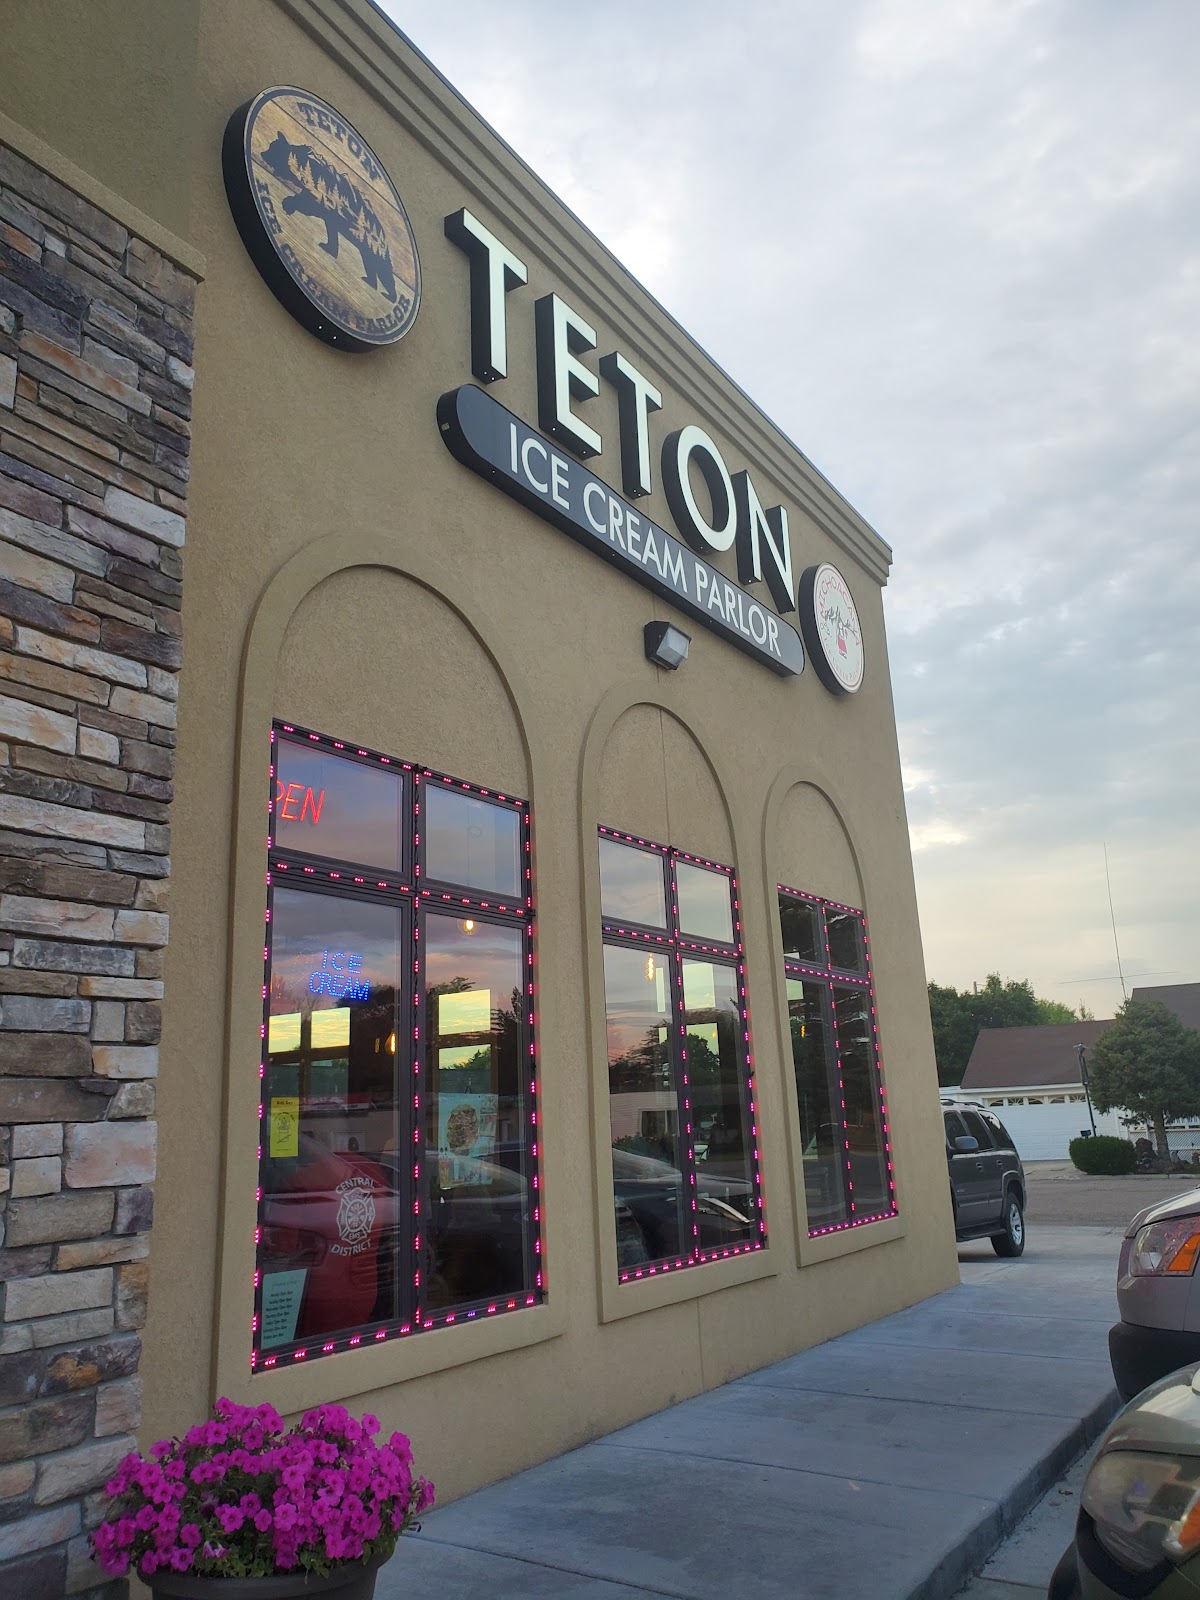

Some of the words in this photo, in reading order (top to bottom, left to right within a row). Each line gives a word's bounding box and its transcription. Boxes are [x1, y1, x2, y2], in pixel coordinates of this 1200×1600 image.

[297, 102, 381, 181] TETON
[255, 179, 283, 235] ICE
[354, 294, 411, 333] PARLOR
[462, 206, 796, 613] TETON
[509, 422, 571, 511] ICE
[582, 481, 689, 594] CREAM
[694, 561, 783, 658] PARLOR
[276, 780, 326, 824] PEN
[322, 950, 363, 975] ICE
[309, 971, 370, 1001] CREAM
[336, 1177, 375, 1195] CENTRAL
[331, 1239, 372, 1257] DISTRICT
